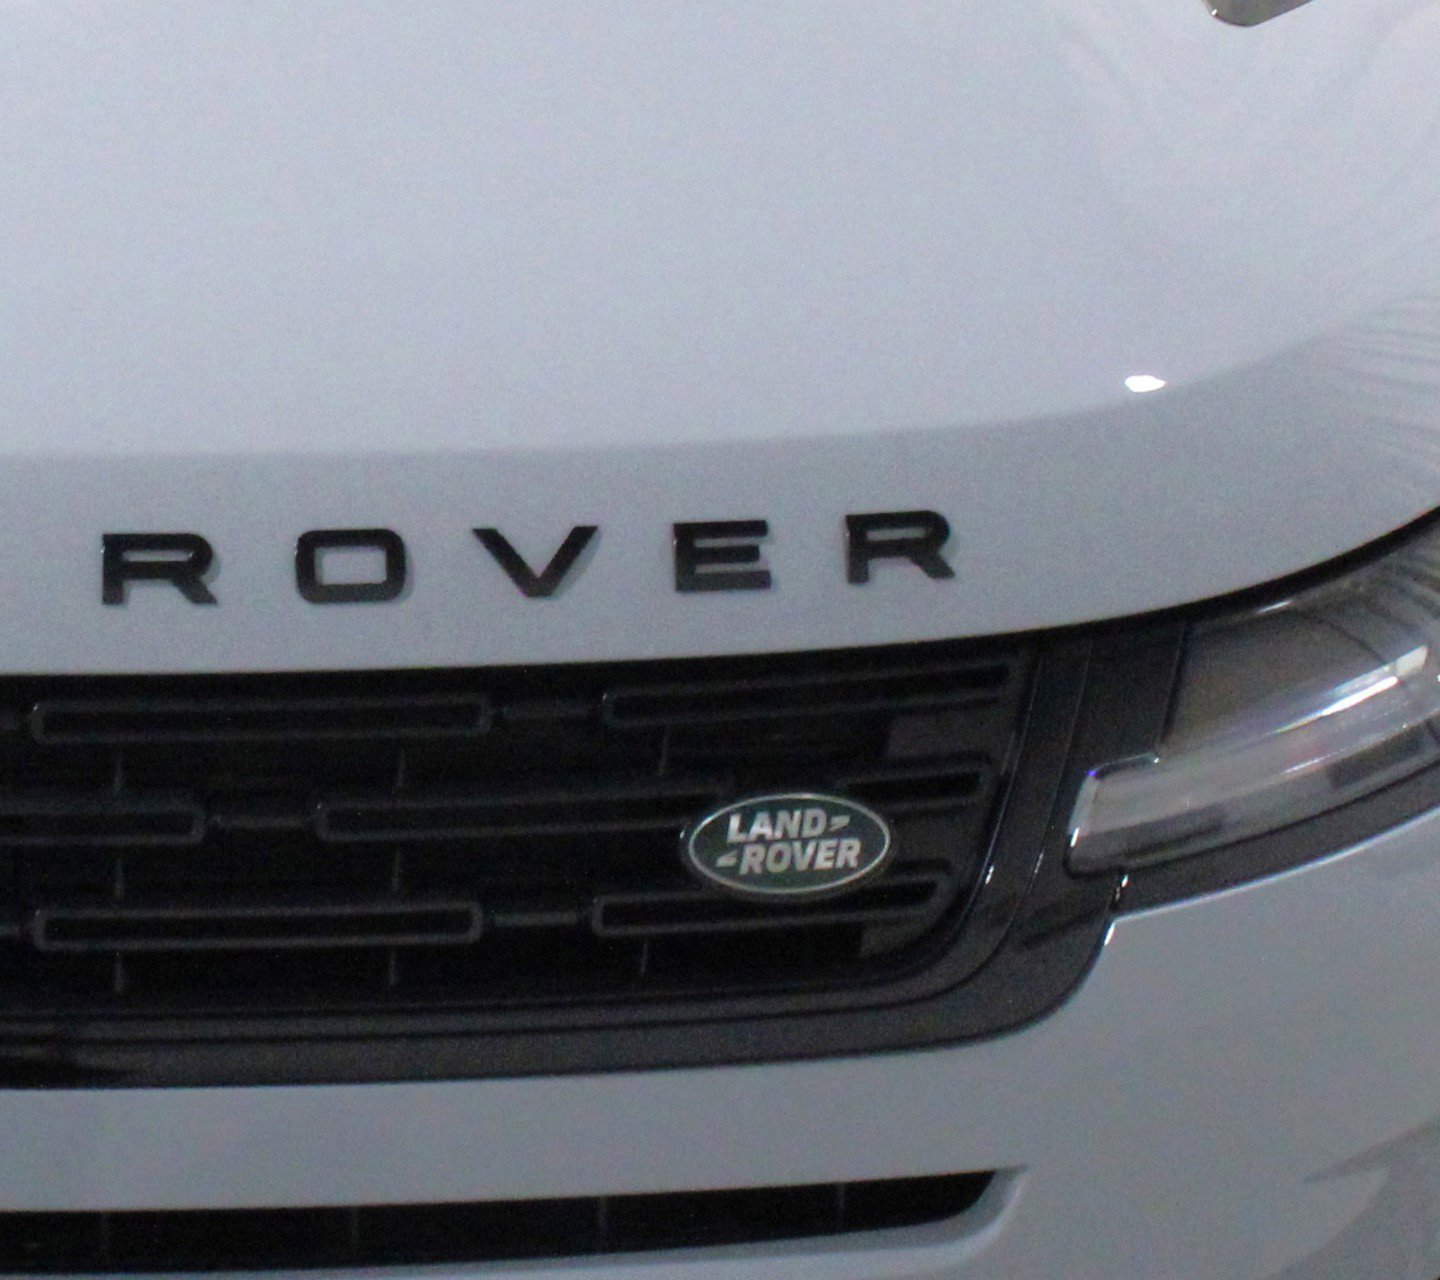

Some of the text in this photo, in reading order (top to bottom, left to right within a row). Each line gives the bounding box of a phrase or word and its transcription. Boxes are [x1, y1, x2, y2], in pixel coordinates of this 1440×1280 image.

[101, 510, 956, 606] ROVER
[726, 808, 828, 843] LAND
[739, 837, 862, 875] ROVER
